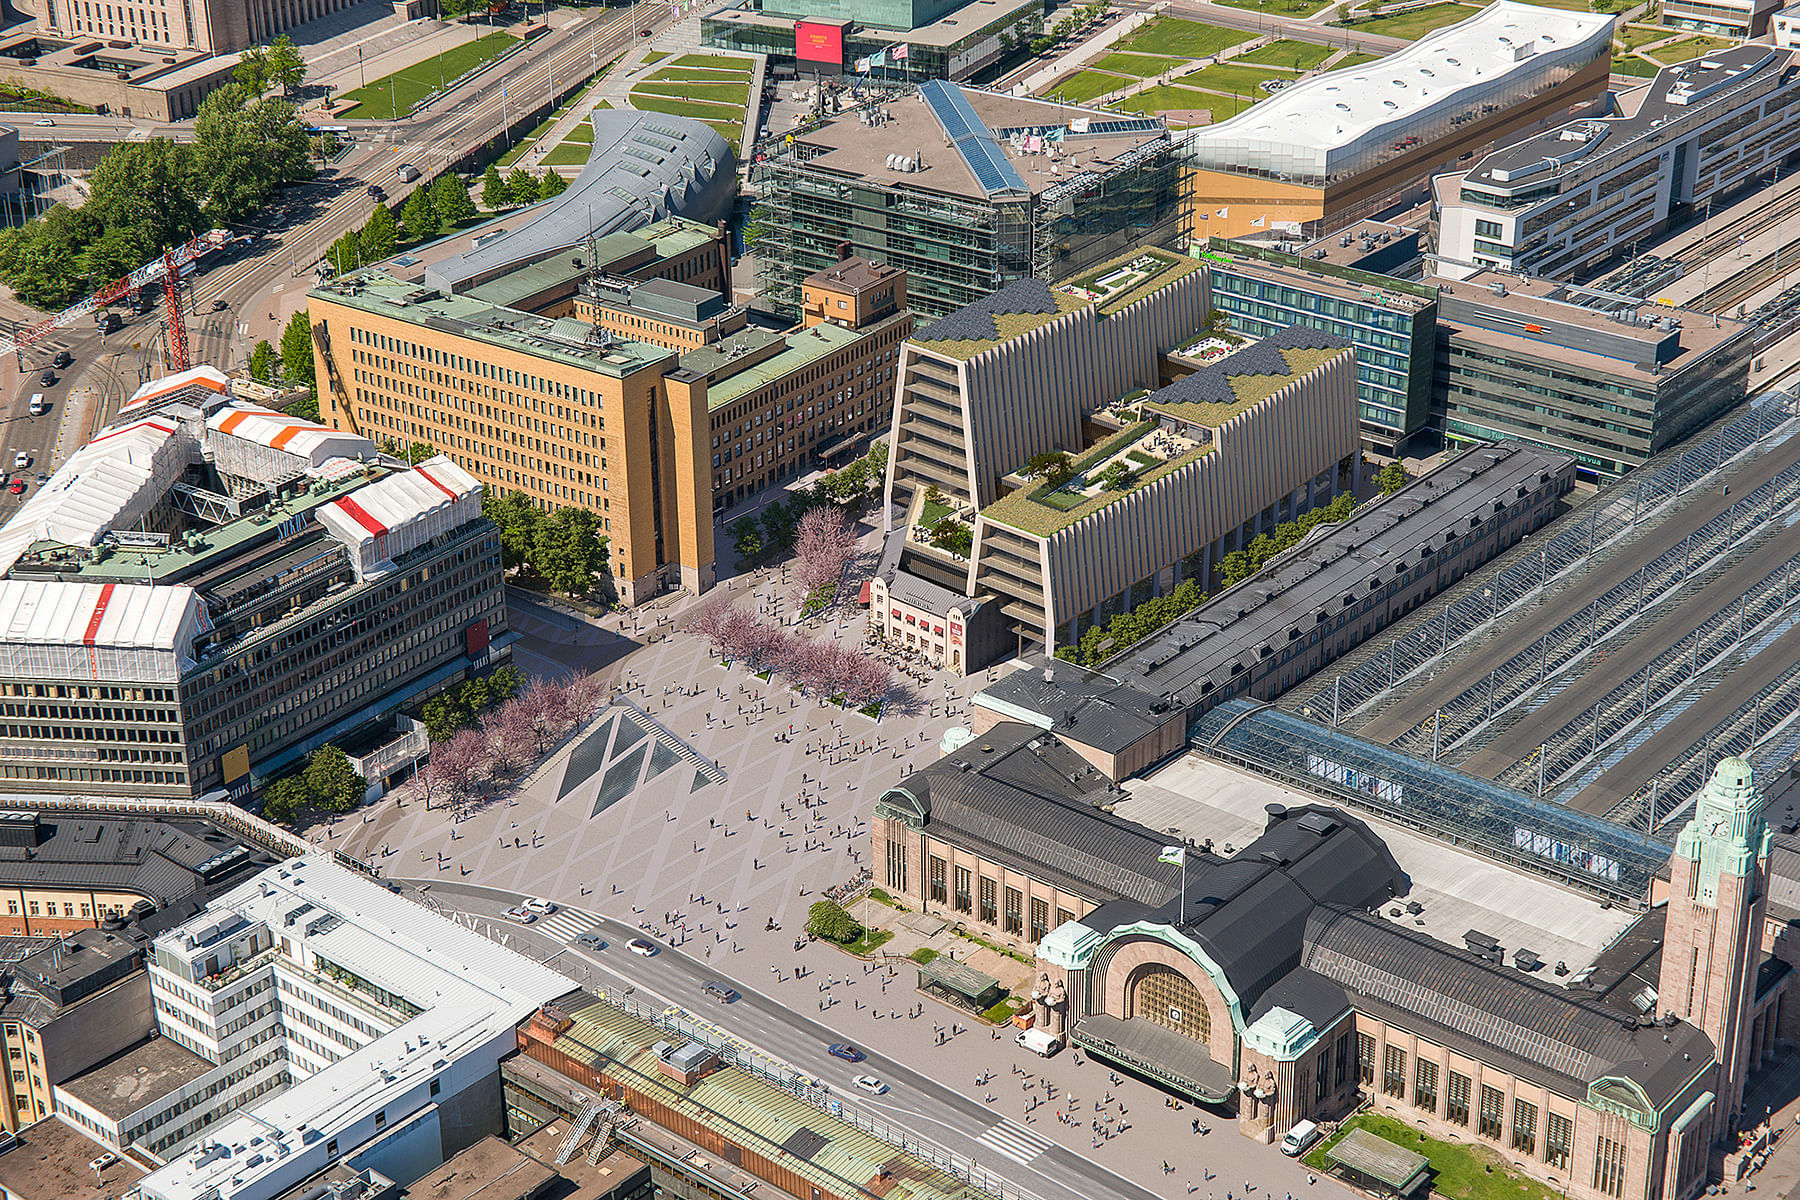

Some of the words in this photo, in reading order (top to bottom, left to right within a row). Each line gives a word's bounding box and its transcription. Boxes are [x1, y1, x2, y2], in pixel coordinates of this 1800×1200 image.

[1201, 250, 1223, 263] Holiday
[1223, 256, 1233, 264] Inn
[1388, 296, 1414, 308] AZETS
[276, 511, 308, 542] SOKOS
[472, 655, 489, 672] SOKOS
[230, 783, 250, 801] SOKOS
